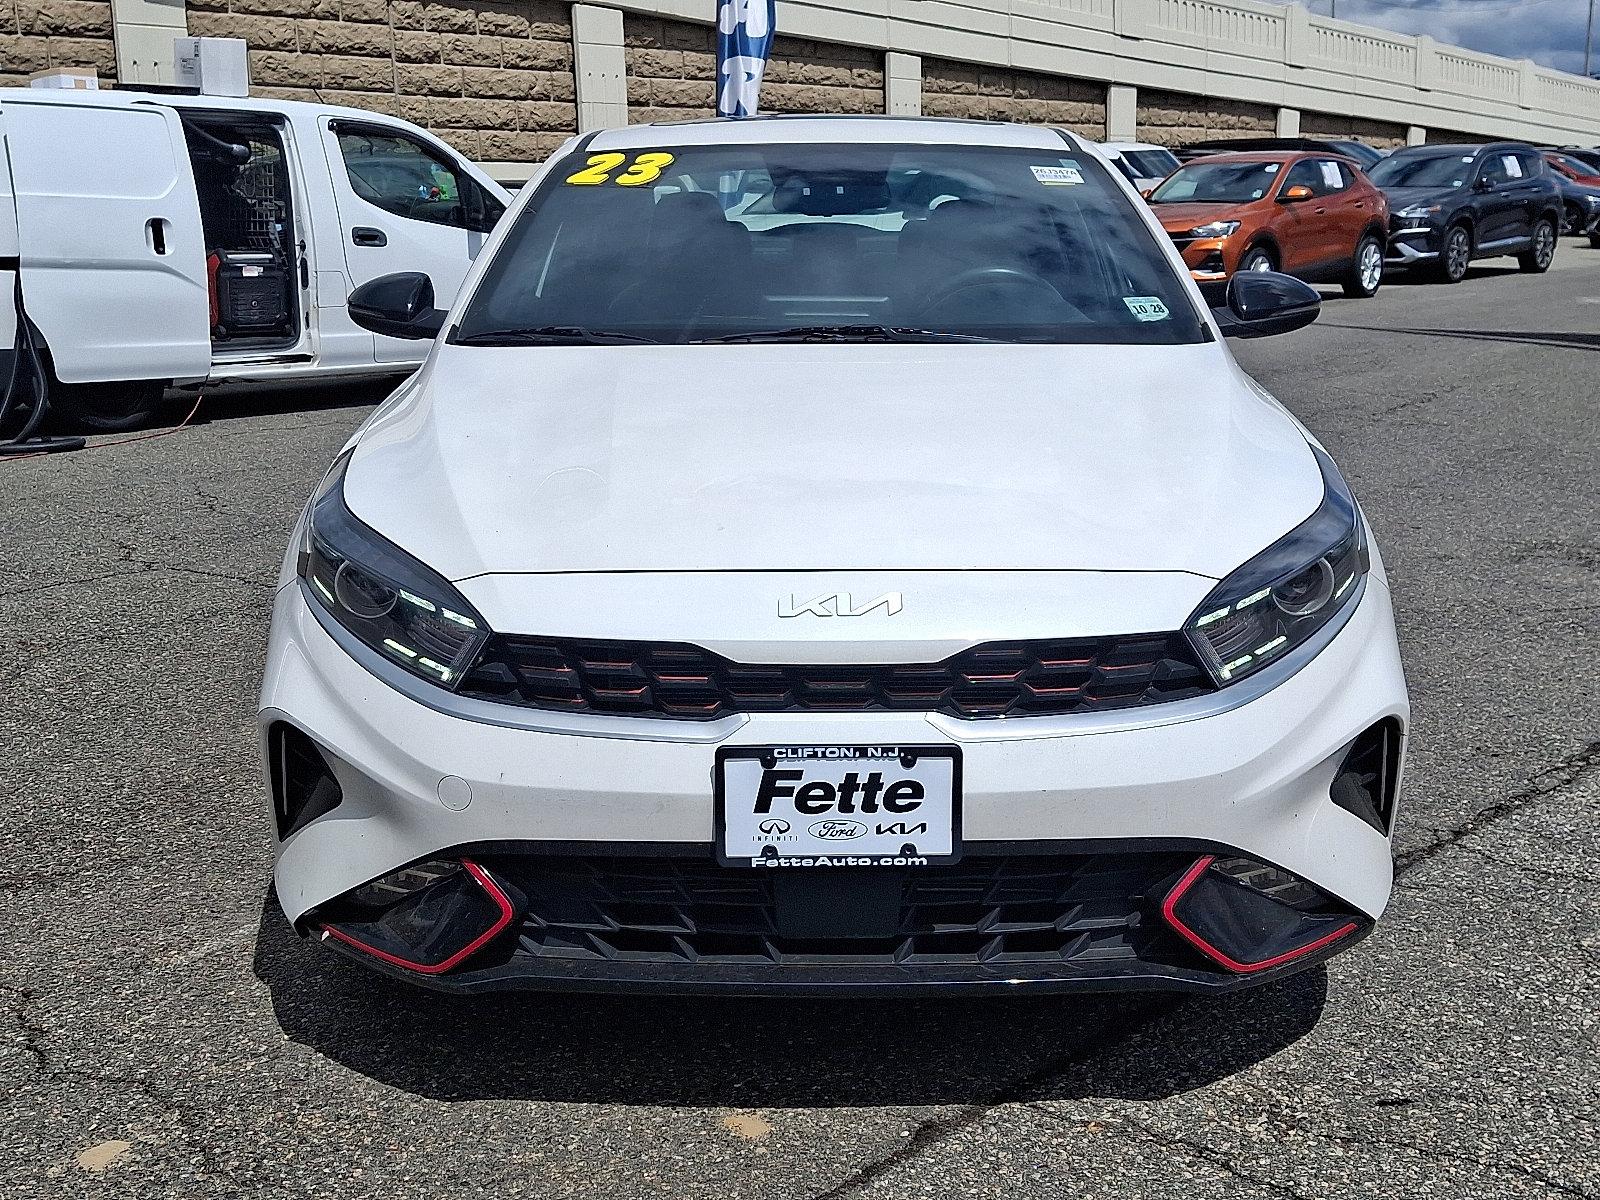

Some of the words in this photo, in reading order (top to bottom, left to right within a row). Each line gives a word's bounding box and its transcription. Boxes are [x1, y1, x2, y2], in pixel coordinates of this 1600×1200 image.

[566, 152, 675, 186] 23
[1133, 304, 1148, 314] 10
[1150, 303, 1165, 314] 28
[773, 747, 860, 758] CLIFTON,
[867, 747, 905, 758] N.J.
[753, 769, 925, 815] Fette
[818, 822, 857, 838] Ford
[751, 857, 928, 868] FetteAuto.com
